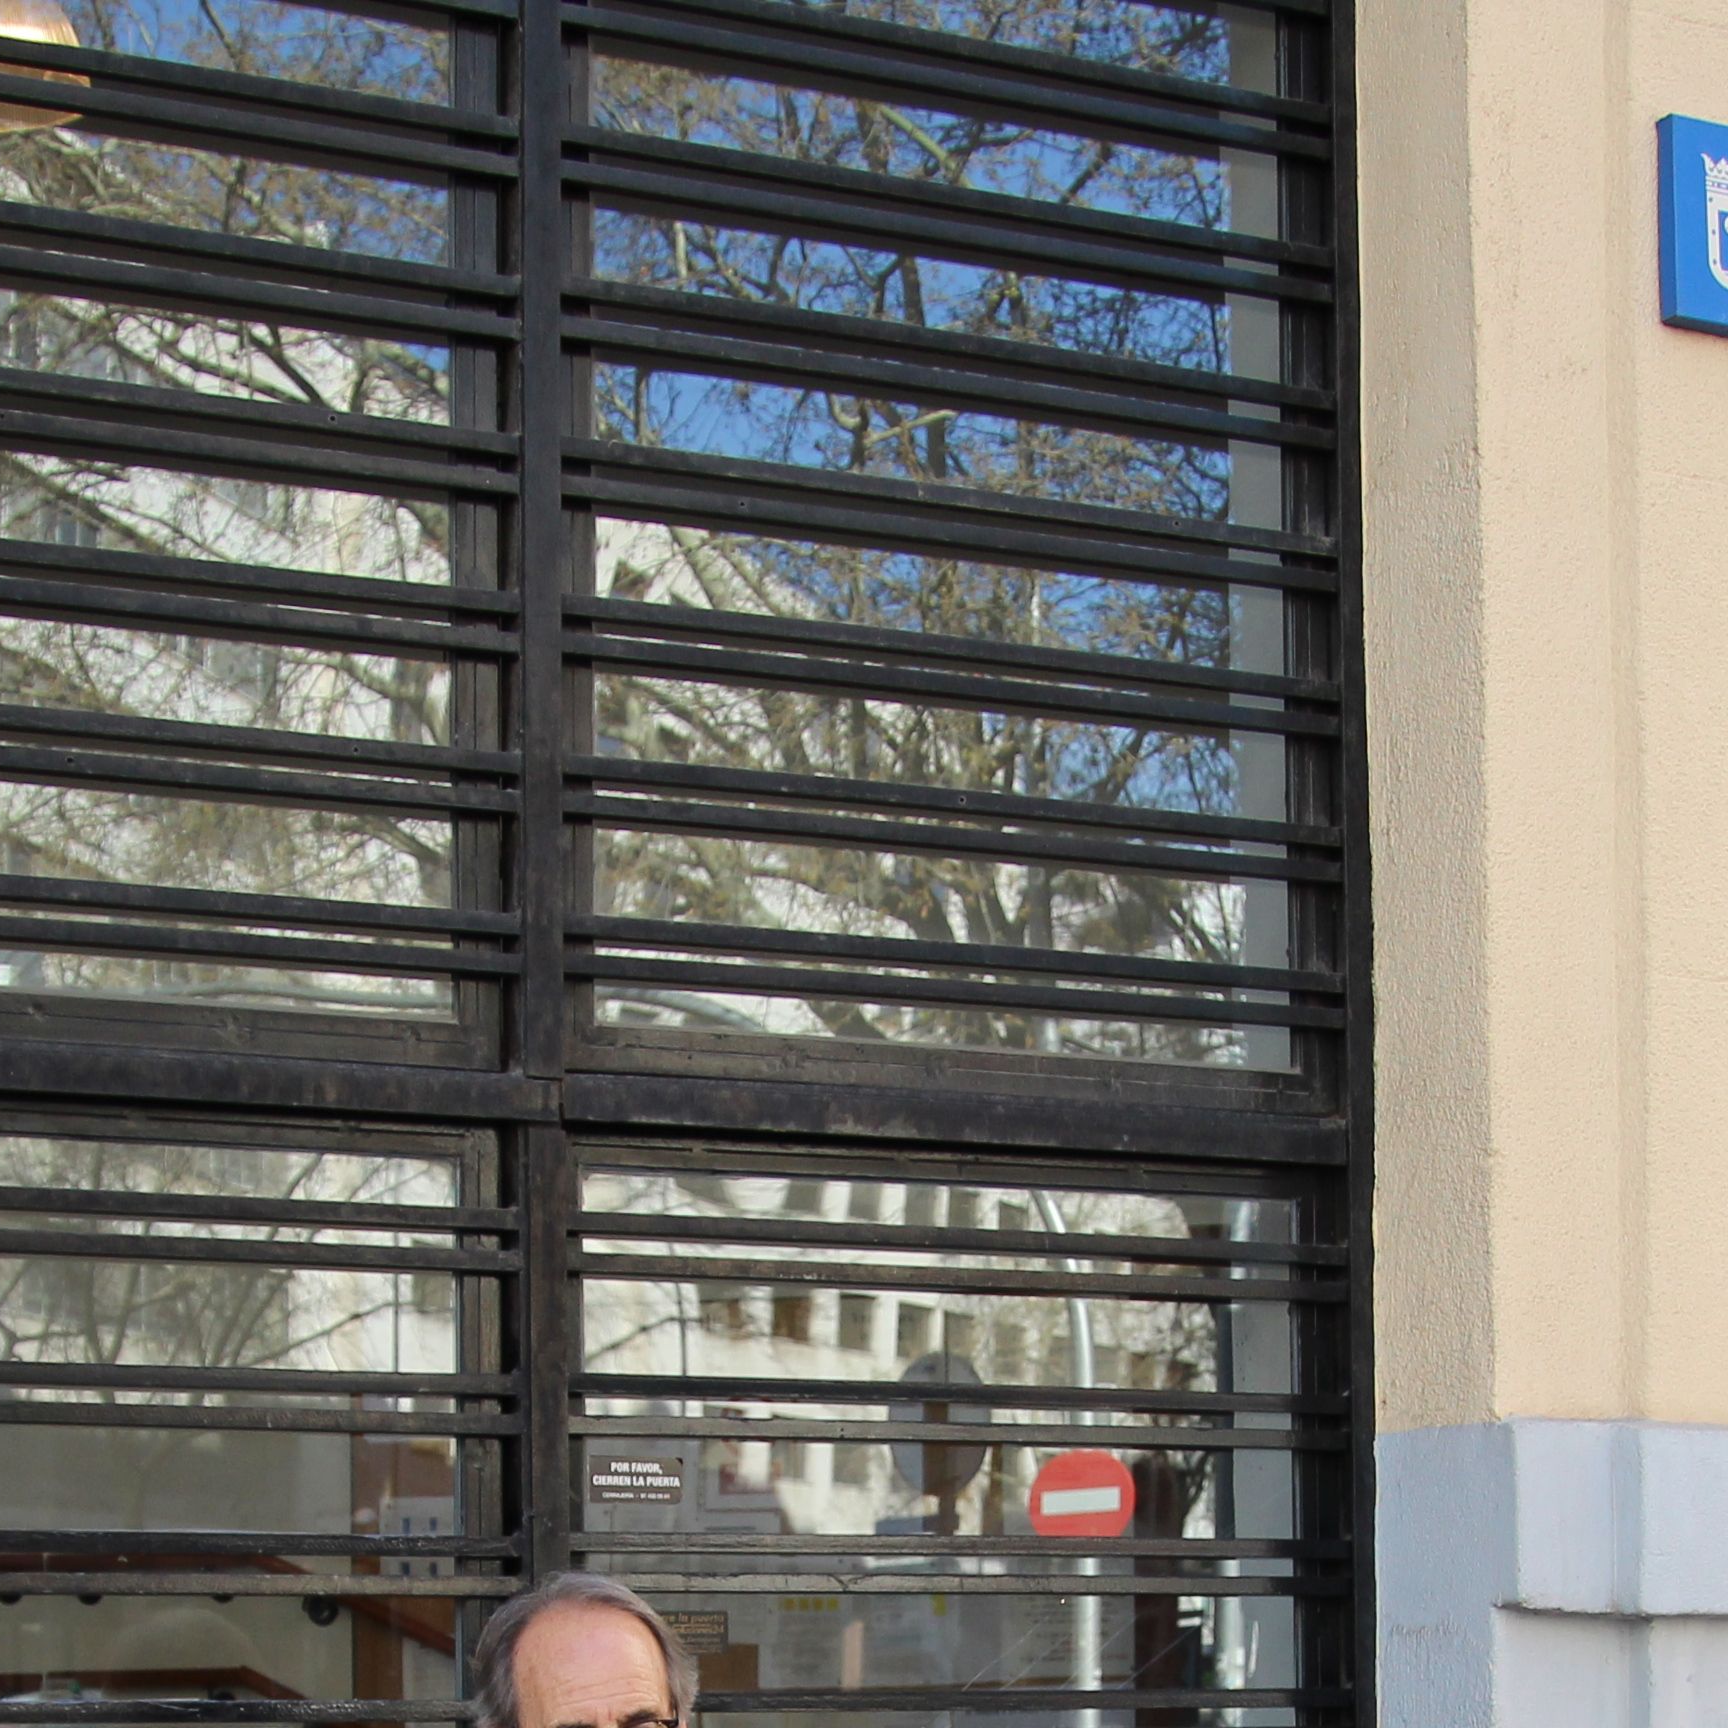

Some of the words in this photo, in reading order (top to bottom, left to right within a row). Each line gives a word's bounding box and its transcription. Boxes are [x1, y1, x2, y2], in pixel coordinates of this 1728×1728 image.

[610, 1462, 629, 1472] POR
[632, 1462, 663, 1474] FAVOR,
[592, 1475, 631, 1486] CIERREN
[633, 1476, 644, 1487] LA
[646, 1476, 680, 1488] PUERTA
